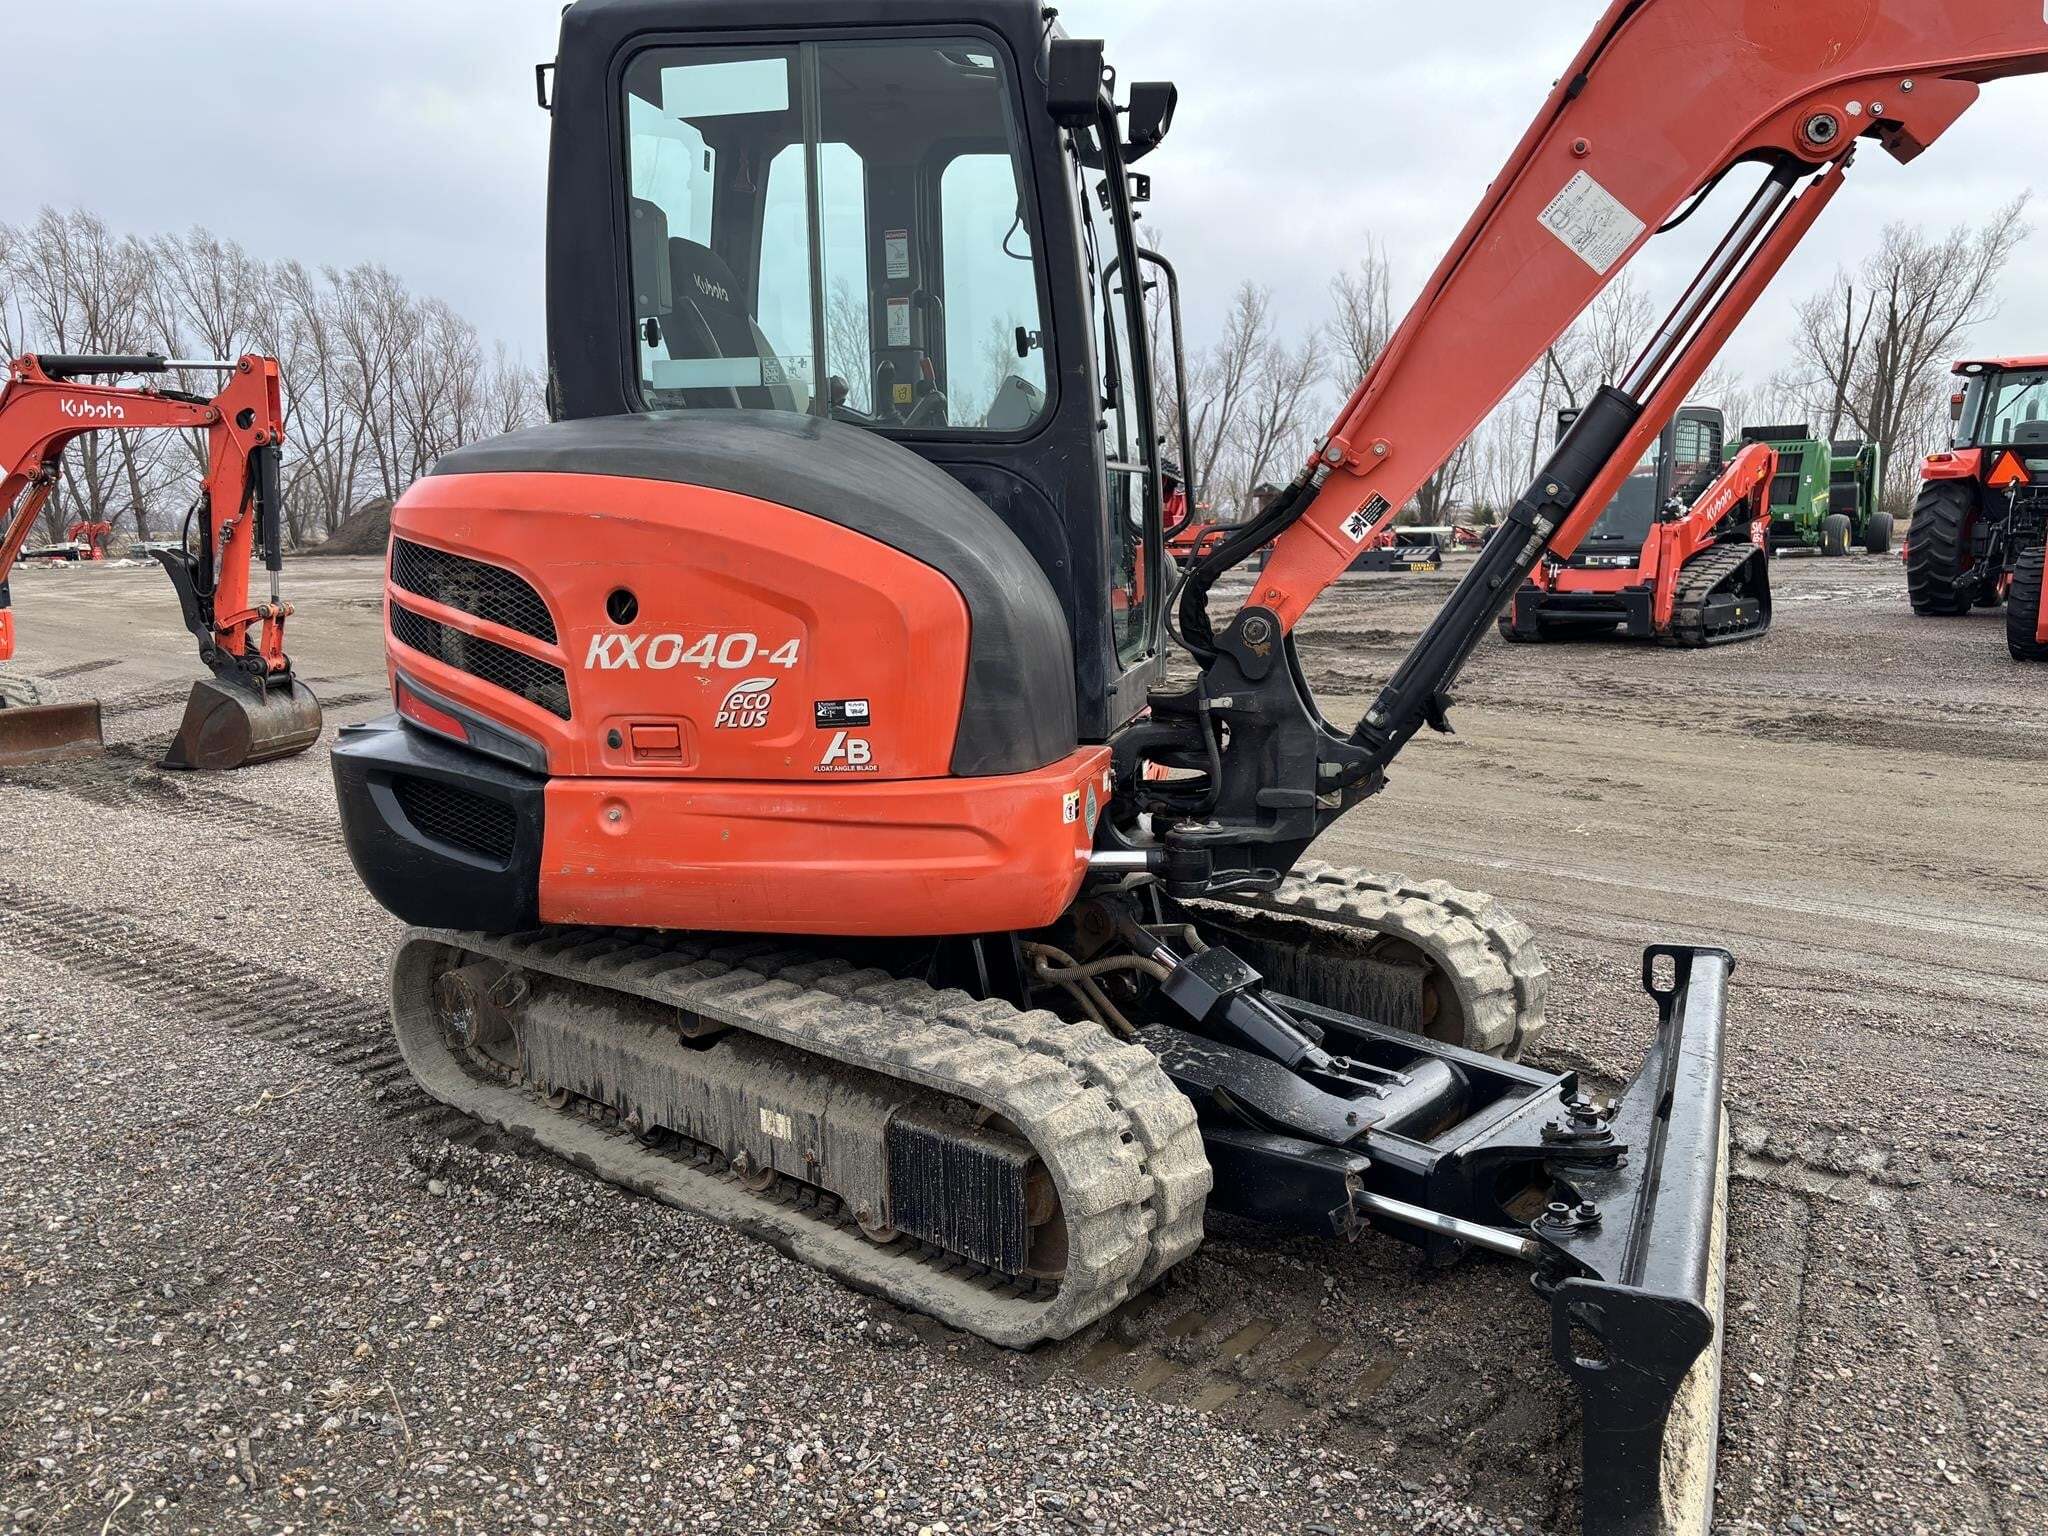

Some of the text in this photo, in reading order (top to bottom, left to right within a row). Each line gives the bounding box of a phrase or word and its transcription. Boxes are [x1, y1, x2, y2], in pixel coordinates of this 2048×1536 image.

[692, 272, 729, 302] Kubota
[60, 398, 125, 419] Kubota
[1706, 488, 1732, 521] Kubota
[584, 632, 801, 670] KX040-4
[729, 692, 771, 711] eco
[714, 710, 769, 729] PLUS
[820, 731, 872, 765] AB
[813, 765, 834, 773] FLOAT
